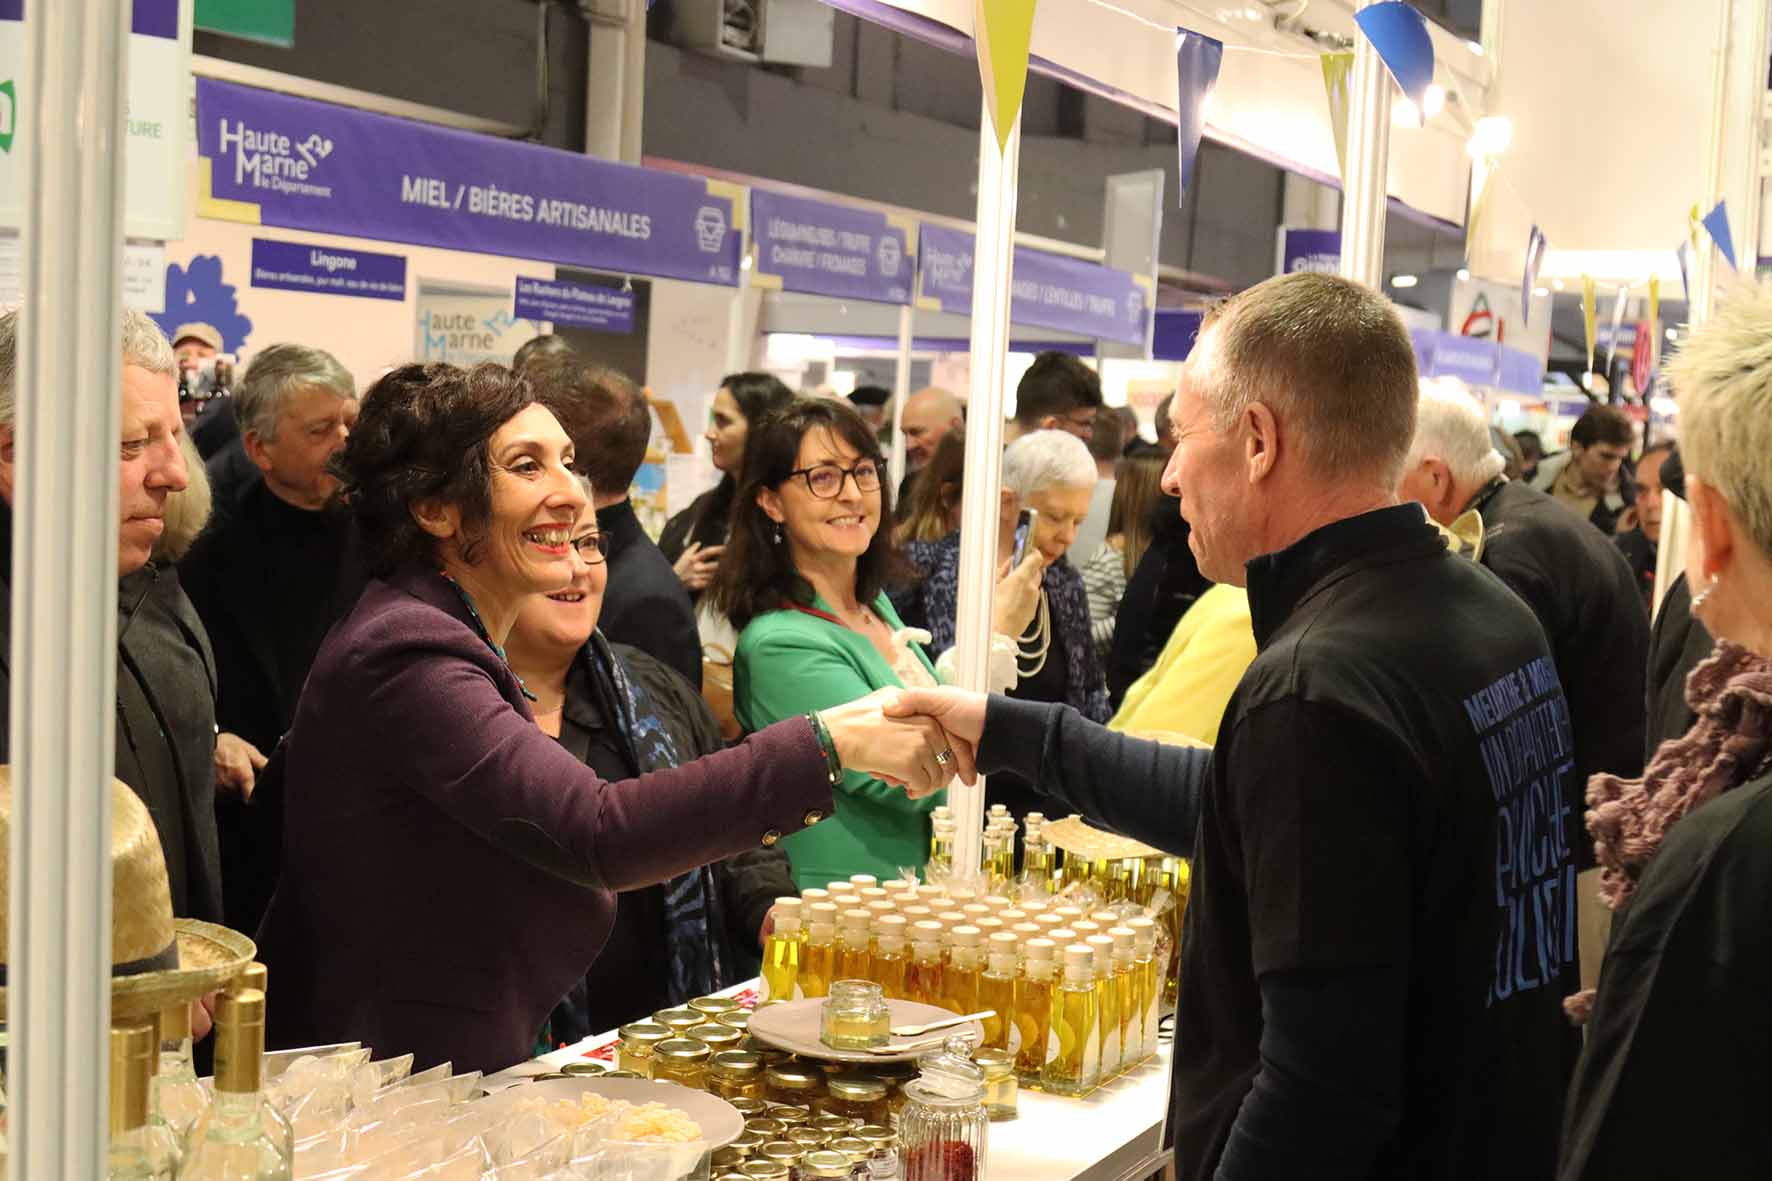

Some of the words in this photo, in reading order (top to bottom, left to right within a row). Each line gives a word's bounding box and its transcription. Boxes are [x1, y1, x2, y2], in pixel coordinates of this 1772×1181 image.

[219, 117, 291, 156] Haute
[235, 151, 310, 188] Marne
[402, 174, 451, 209] MIEL
[453, 184, 466, 211] /
[468, 182, 535, 222] BIÈRES
[536, 197, 652, 241] ARTISANALES
[309, 249, 358, 272] Lingone
